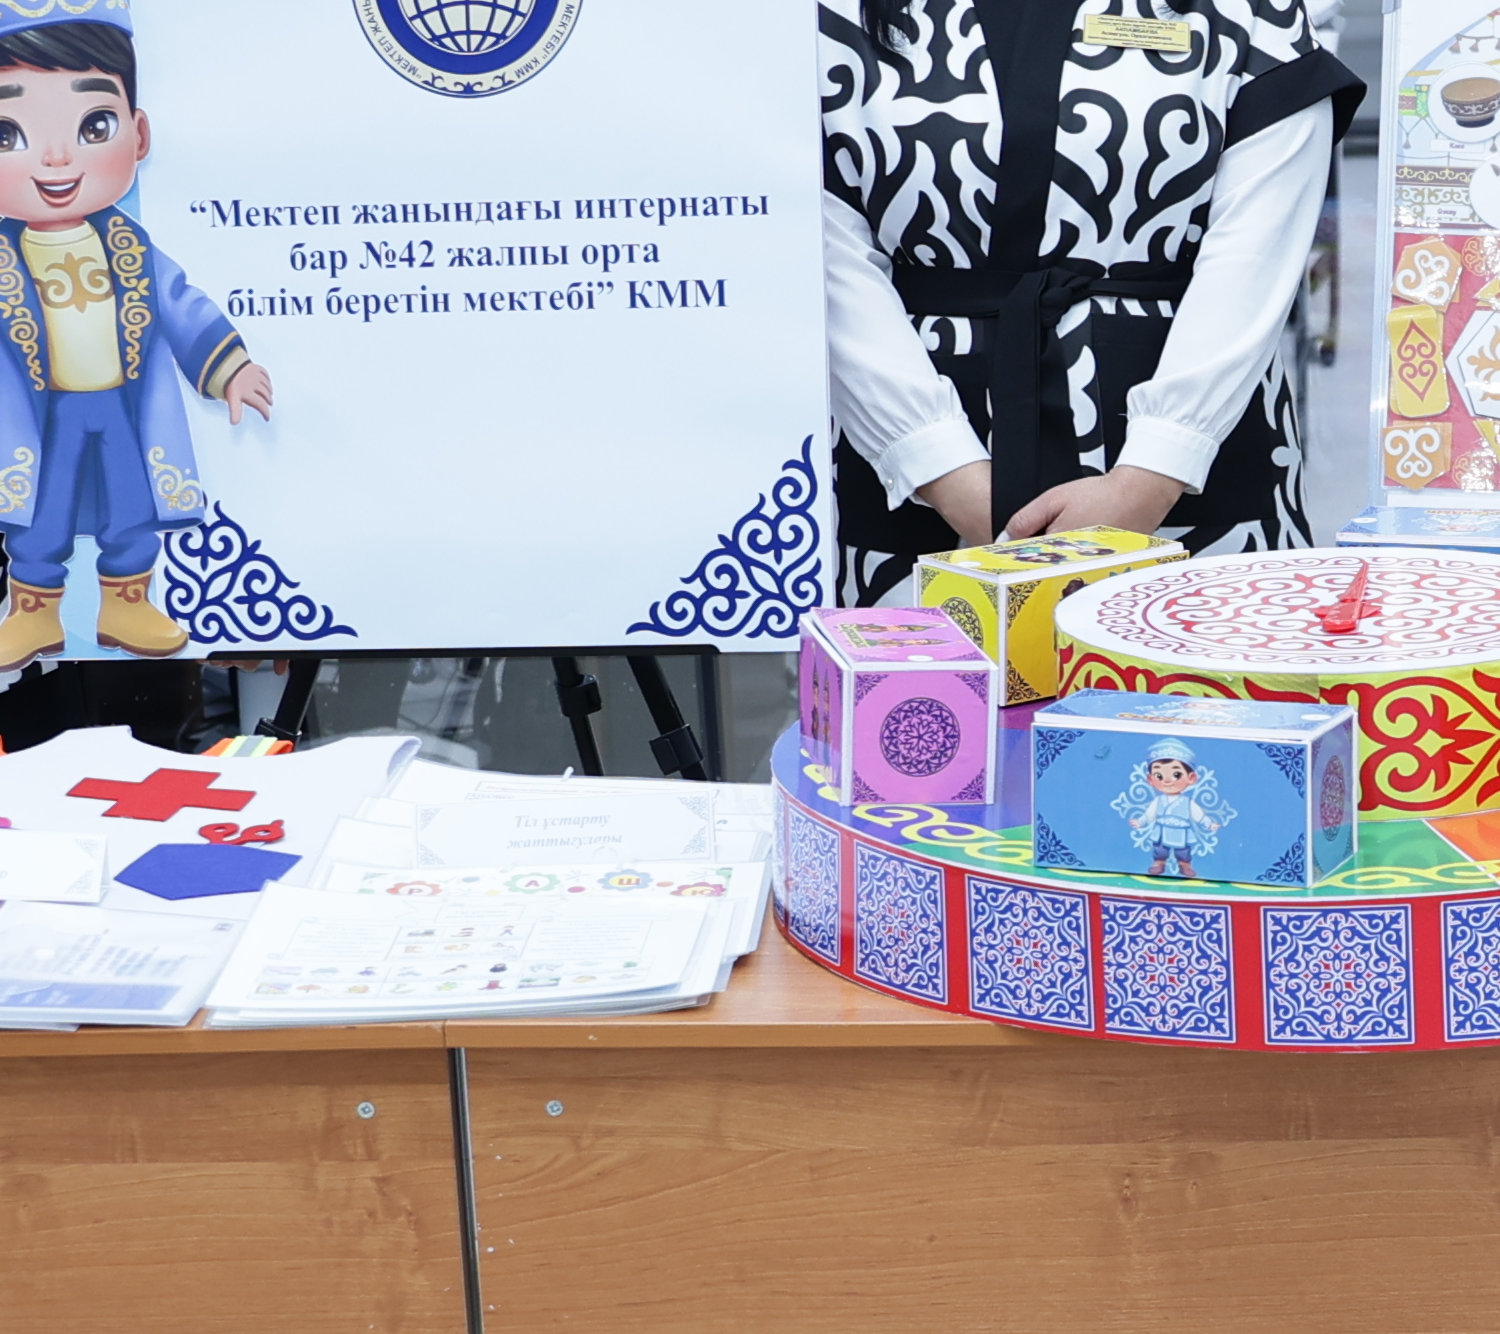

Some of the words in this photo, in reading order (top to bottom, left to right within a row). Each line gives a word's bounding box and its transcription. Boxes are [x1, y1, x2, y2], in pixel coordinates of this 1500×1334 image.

[514, 55, 541, 79] КММ
[189, 198, 341, 228] “Мектеп
[352, 196, 562, 224] жанындағы
[574, 193, 771, 226] интернаты
[289, 242, 349, 278] бар
[359, 239, 436, 270] №42
[446, 241, 570, 269] жалпы
[581, 240, 661, 275] орта
[227, 288, 314, 318] білім
[325, 284, 452, 323] беретін
[463, 281, 615, 314] мектебі”
[625, 278, 729, 310] КММ
[514, 814, 540, 829] Тіл
[541, 813, 612, 830] ұстарту
[524, 879, 540, 888] А
[618, 876, 641, 886] Ш
